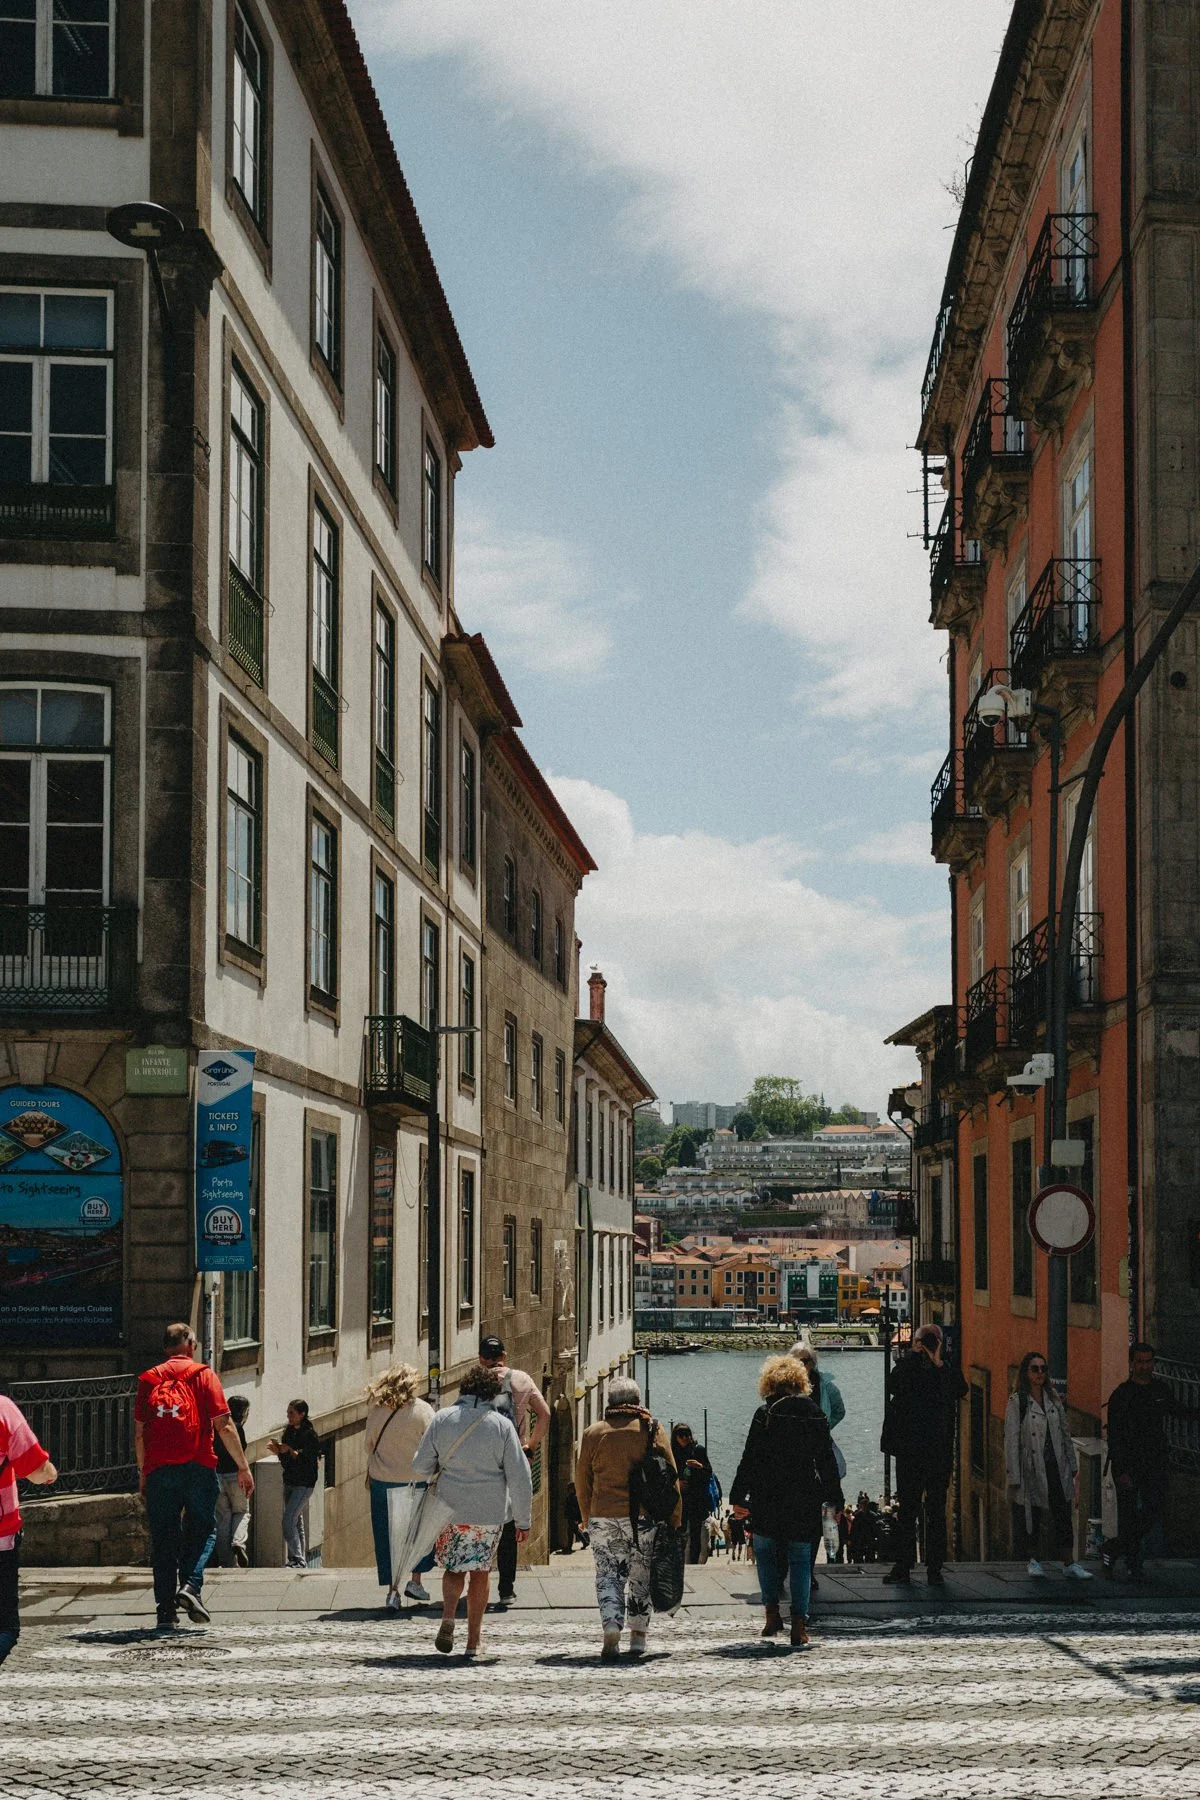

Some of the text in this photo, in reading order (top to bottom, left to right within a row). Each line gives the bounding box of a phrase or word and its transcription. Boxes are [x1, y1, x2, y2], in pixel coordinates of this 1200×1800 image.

[141, 1057, 171, 1066] INFANTE
[142, 1067, 180, 1077] HENRIQUE
[37, 1100, 60, 1108] TOURS
[208, 1112, 239, 1120] TICKETS
[208, 1123, 238, 1132] & INFO
[211, 1176, 233, 1188] Porto
[18, 1181, 81, 1198] Sightseeing
[201, 1189, 244, 1201] Sightseeing
[212, 1215, 234, 1225] BUY
[212, 1224, 234, 1232] HERE
[59, 1305, 86, 1313] Bridges
